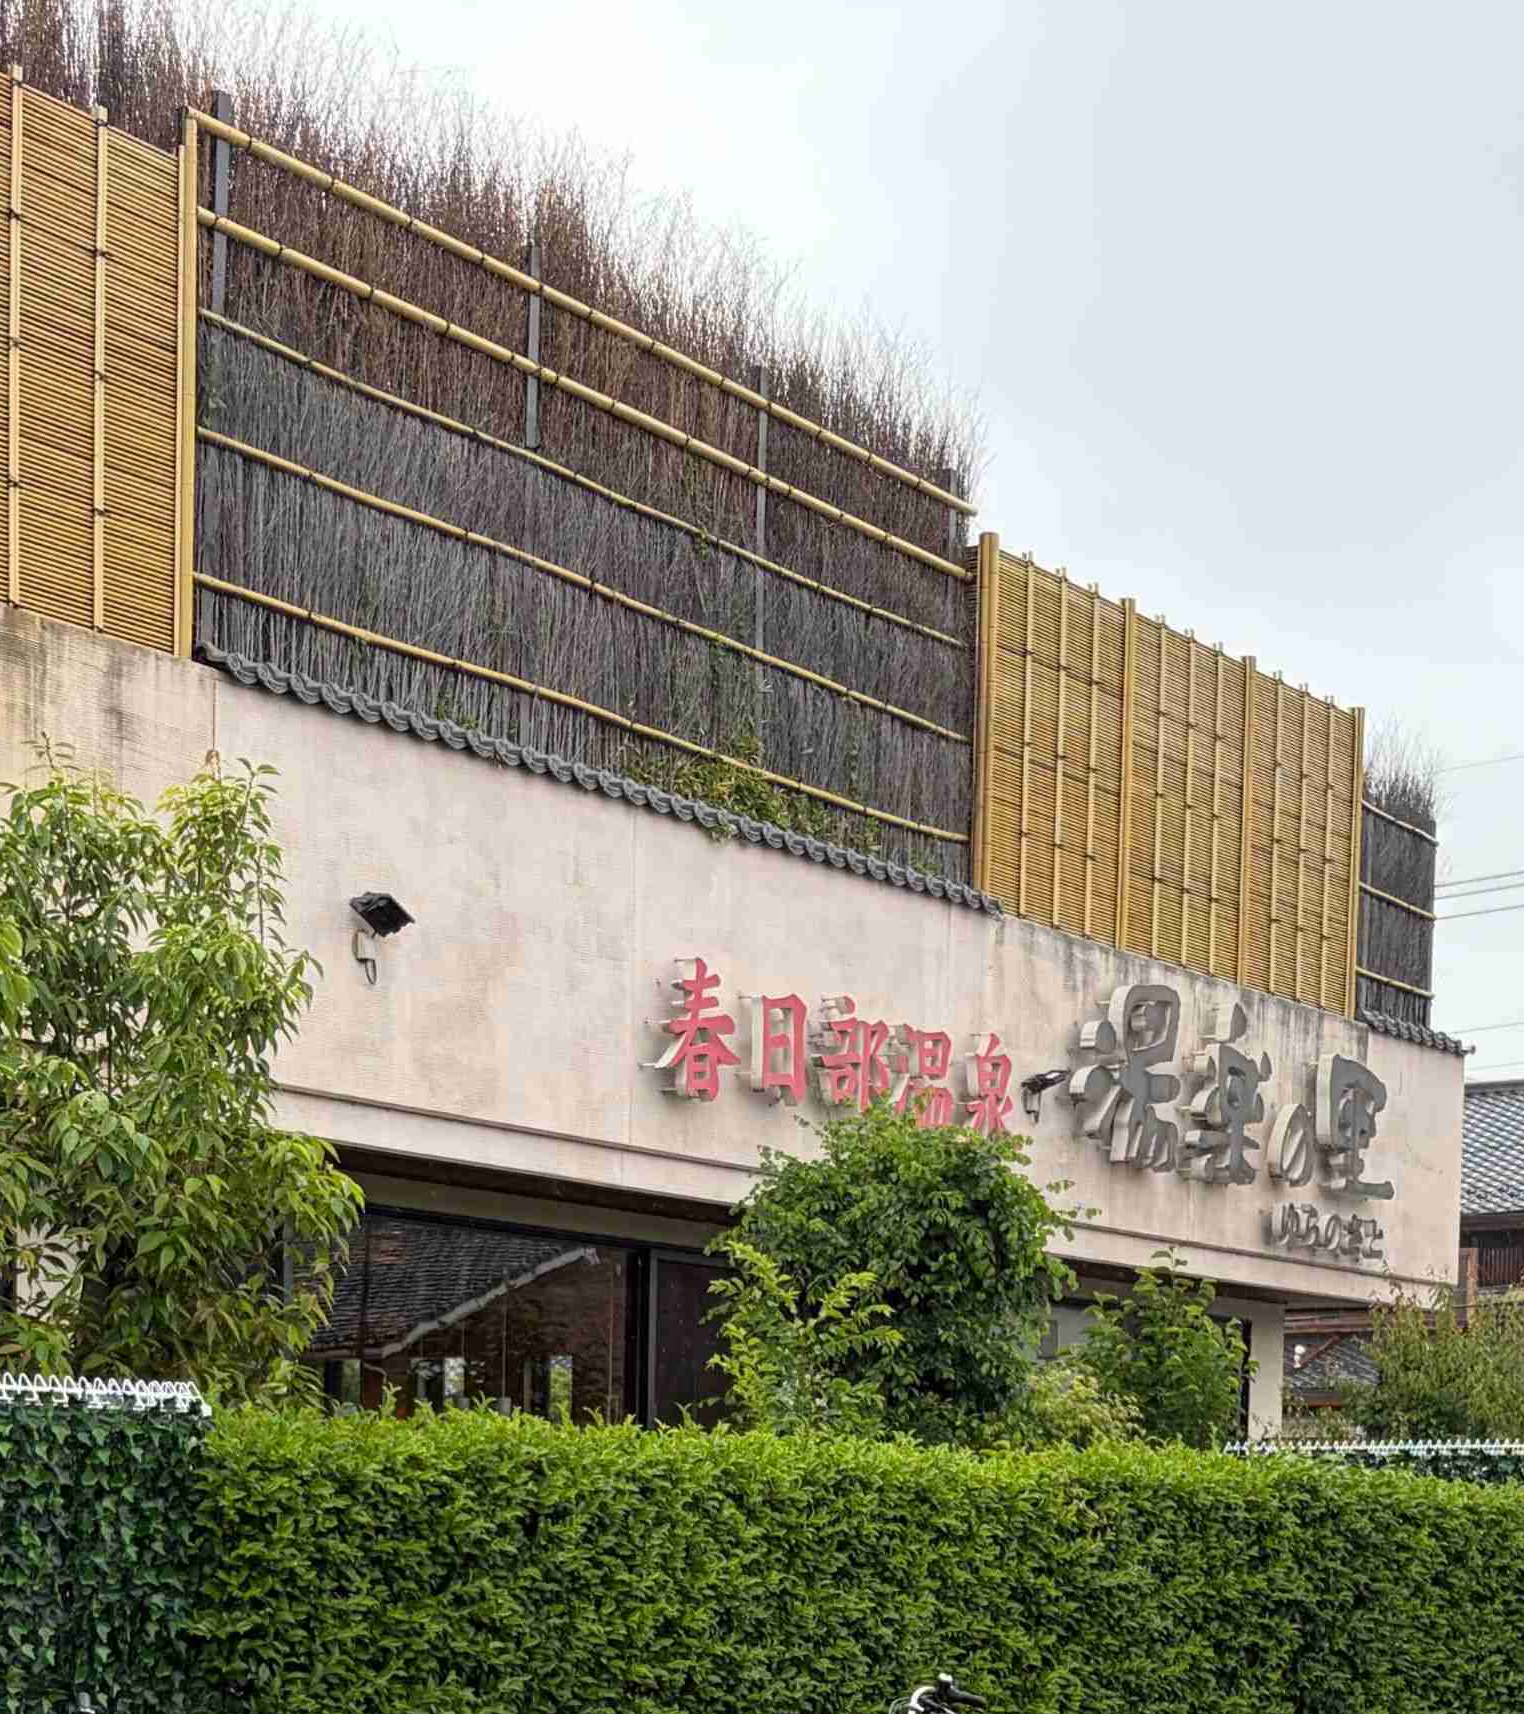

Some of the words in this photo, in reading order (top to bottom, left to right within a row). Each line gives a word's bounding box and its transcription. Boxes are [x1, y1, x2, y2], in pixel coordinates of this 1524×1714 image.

[657, 957, 1014, 1132] 春日部温泉
[1069, 984, 1395, 1200] 湯楽の里
